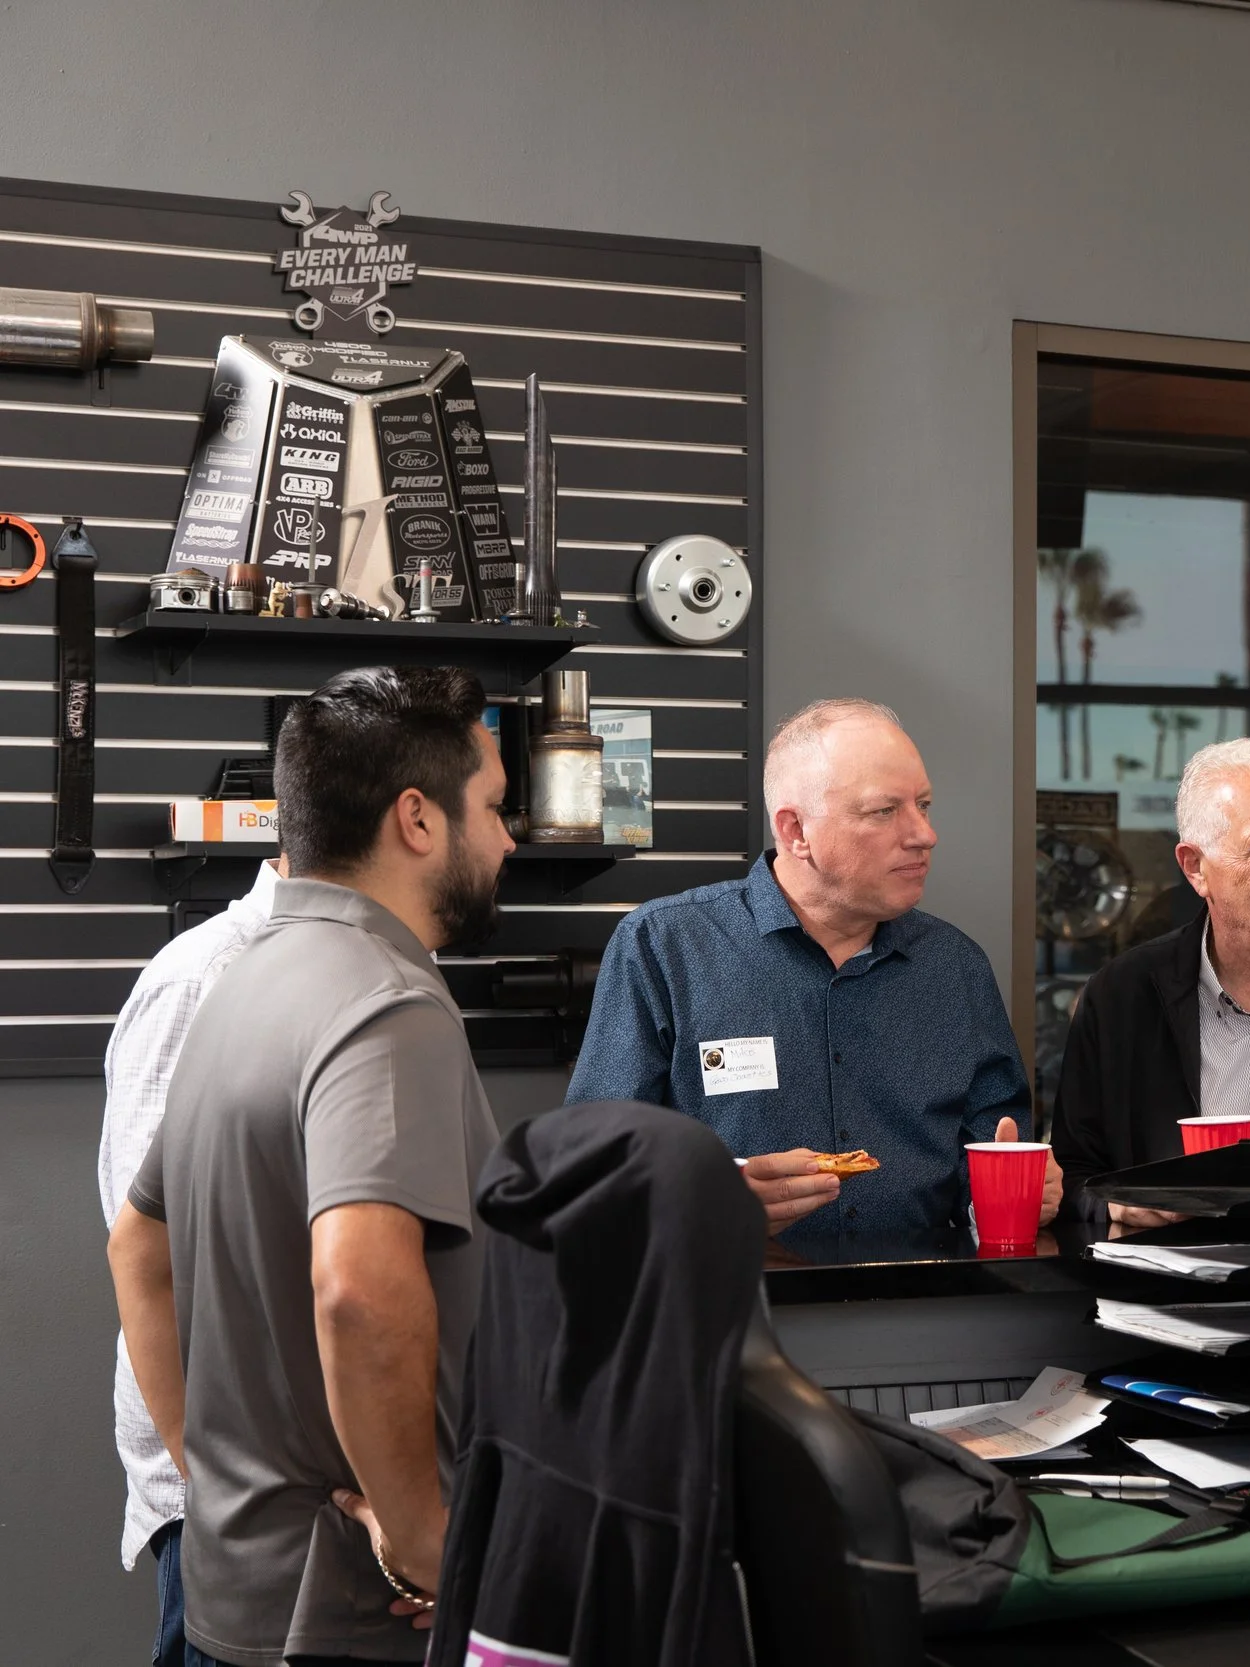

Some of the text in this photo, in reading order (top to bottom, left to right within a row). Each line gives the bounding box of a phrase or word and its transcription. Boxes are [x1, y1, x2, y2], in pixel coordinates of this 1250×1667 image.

[354, 224, 372, 232] 2021
[280, 244, 407, 269] EVERY MAN
[289, 263, 416, 287] CHALLENGE
[312, 346, 388, 357] MODIFIED
[350, 356, 430, 367] LASERNUT
[301, 406, 344, 421] Griffin
[284, 448, 337, 462] KING
[397, 452, 429, 468] Ford
[465, 464, 489, 475] BOXO
[286, 477, 328, 495] ARB
[391, 475, 443, 488] RIGID
[461, 484, 496, 495] PROGRESSIVE
[194, 494, 243, 511] OPTIMA
[396, 494, 445, 503] METHOD
[276, 508, 312, 543] VP
[472, 513, 496, 526] WARN
[408, 520, 442, 533] BRANIK
[476, 543, 507, 555] MBRP
[182, 553, 240, 565] LASERNUT
[263, 549, 332, 570] PRP
[597, 722, 624, 735] ROAD
